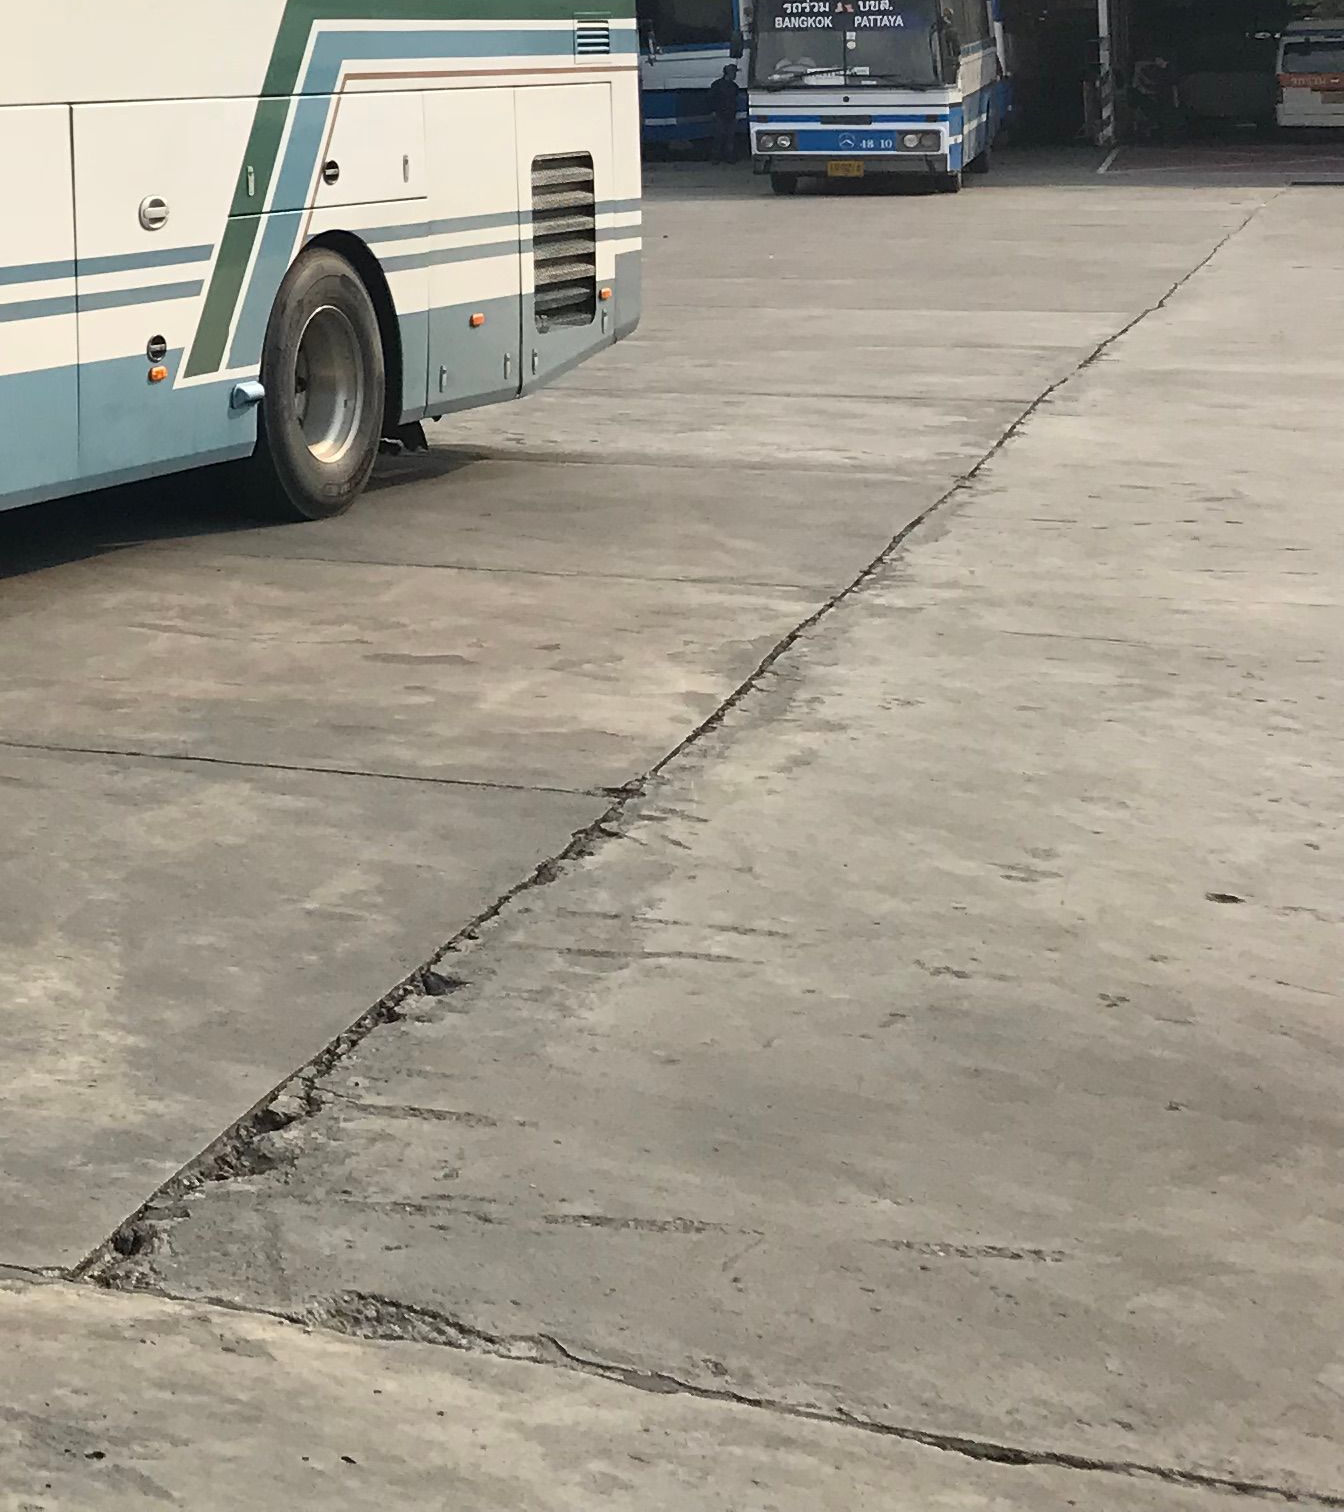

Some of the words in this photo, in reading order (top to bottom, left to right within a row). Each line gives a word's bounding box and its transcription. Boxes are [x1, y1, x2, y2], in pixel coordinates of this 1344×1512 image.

[782, 0, 830, 14] รถร่วม
[858, 0, 894, 11] บขส.
[775, 16, 833, 29] BANGKOK
[854, 15, 904, 28] PATTAYA
